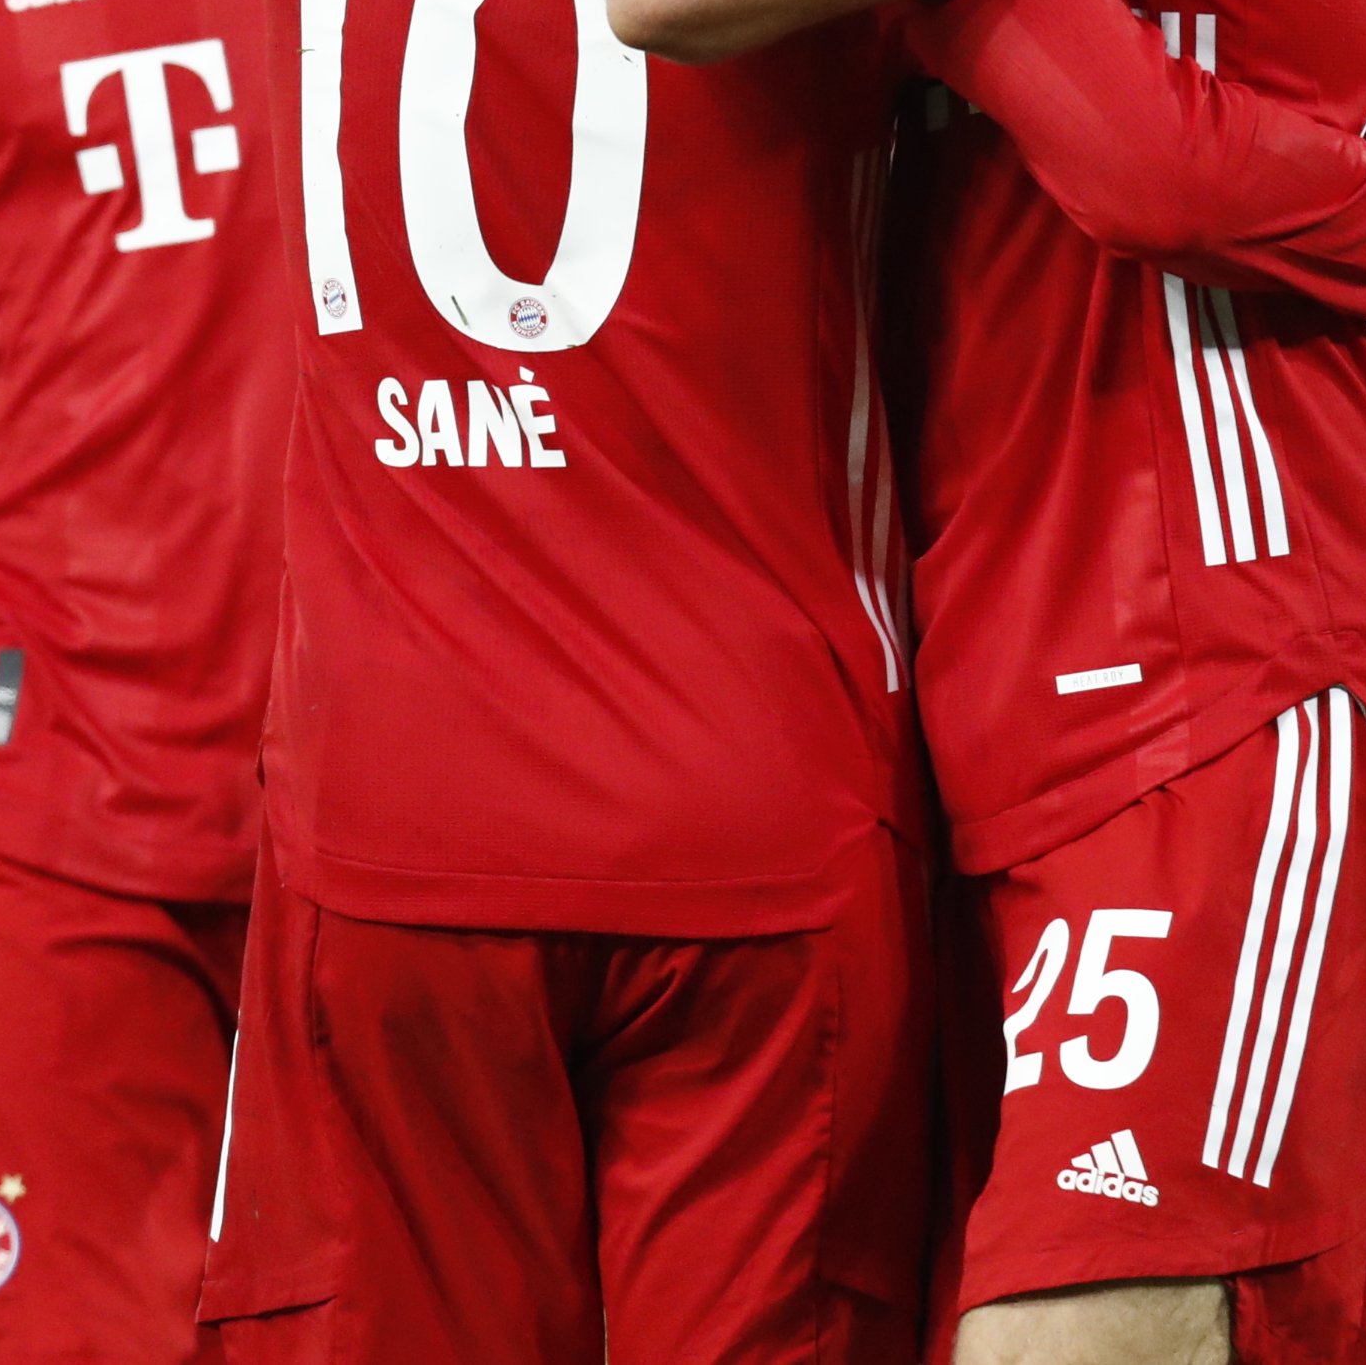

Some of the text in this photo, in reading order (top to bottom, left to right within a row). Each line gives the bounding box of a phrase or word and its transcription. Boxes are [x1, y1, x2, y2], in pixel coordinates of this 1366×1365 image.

[60, 38, 240, 253] T
[1002, 908, 1173, 1097] 25
[1056, 1168, 1160, 1207] adidas
